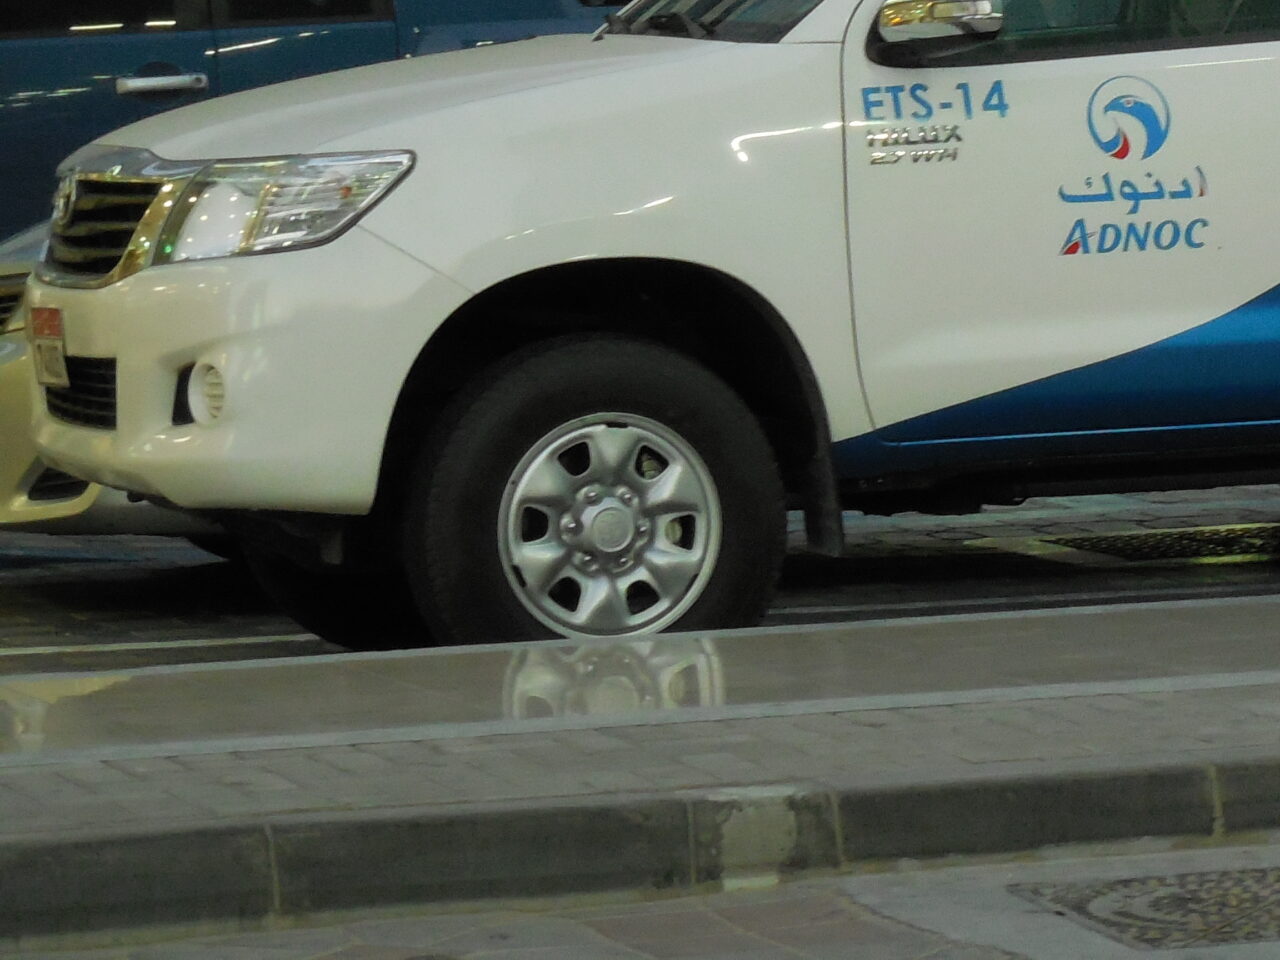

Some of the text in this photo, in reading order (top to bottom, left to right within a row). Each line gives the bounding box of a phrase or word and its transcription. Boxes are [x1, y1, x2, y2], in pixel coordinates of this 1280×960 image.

[861, 80, 1009, 122] ETS-14
[1058, 166, 1207, 216] ادنوك
[1058, 218, 1210, 256] ADNOC
